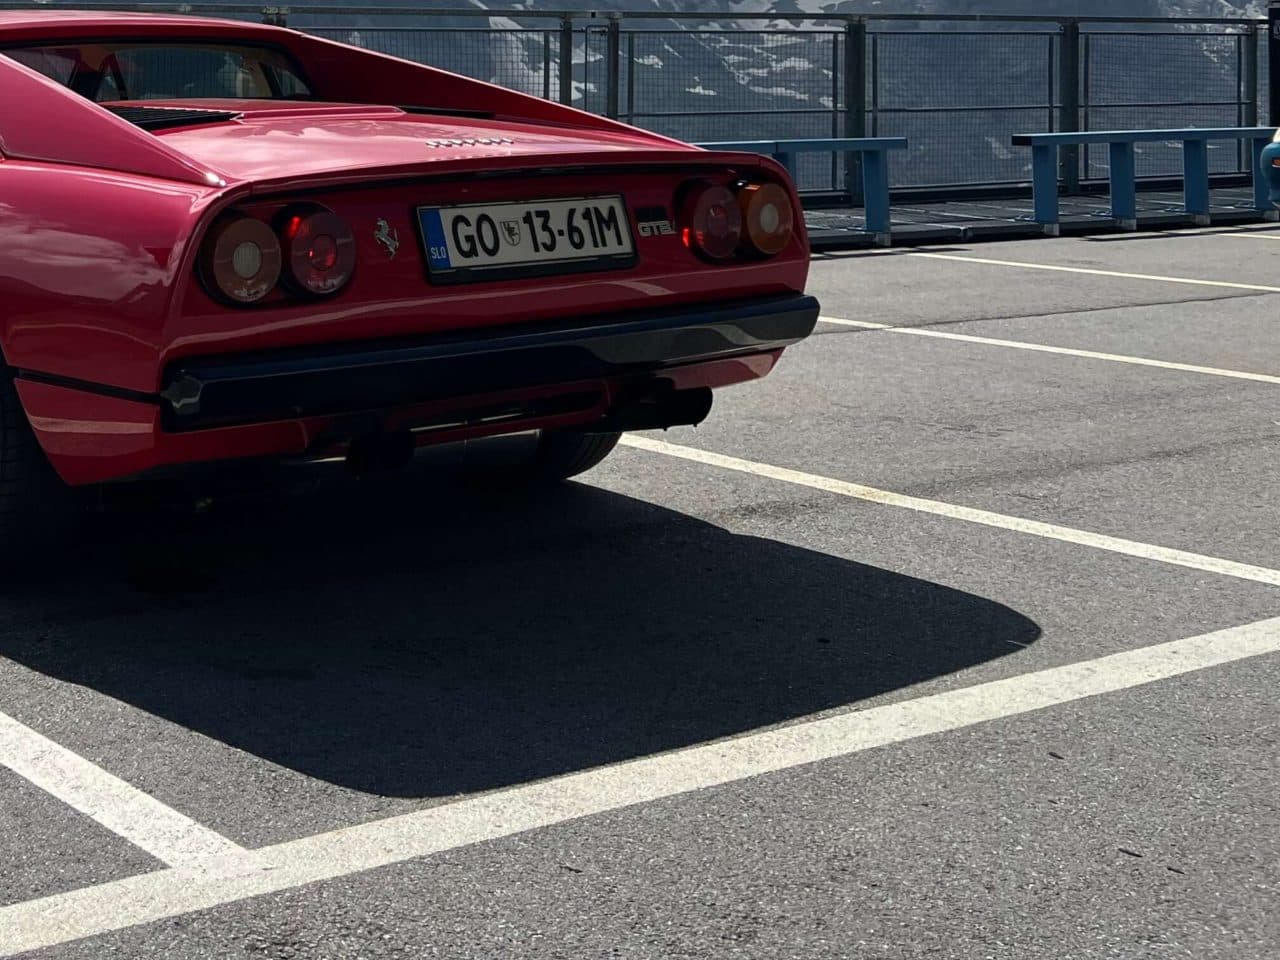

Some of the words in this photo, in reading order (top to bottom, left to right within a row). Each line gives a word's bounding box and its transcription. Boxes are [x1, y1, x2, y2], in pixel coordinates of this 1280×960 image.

[451, 213, 501, 259] GO
[522, 205, 624, 253] 13-61M
[430, 246, 447, 259] SLO
